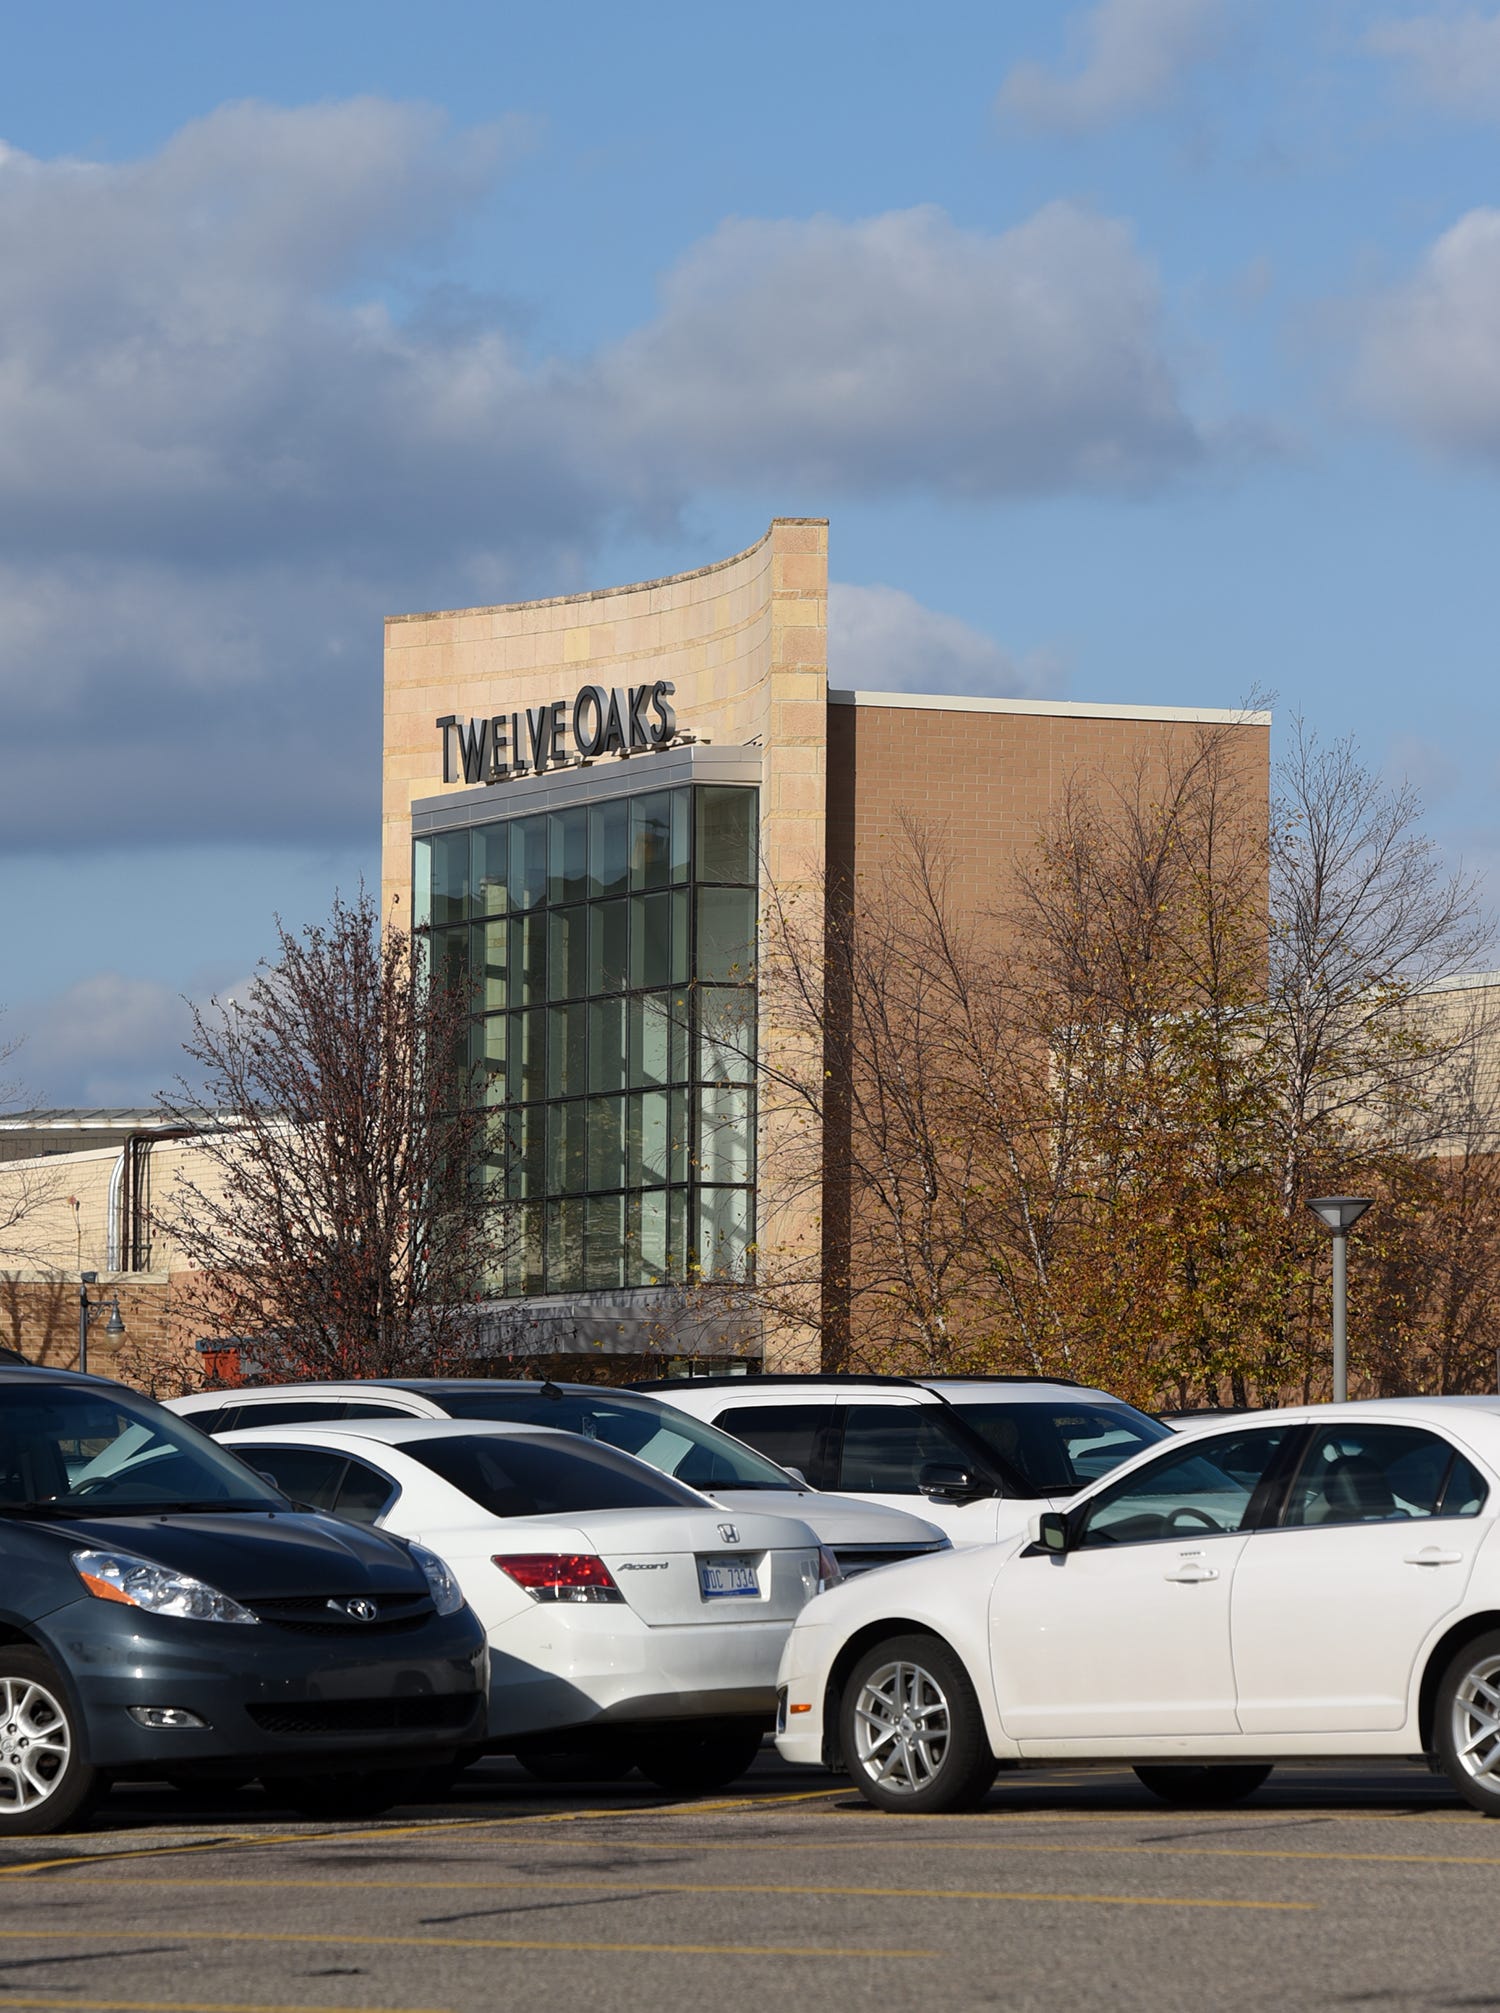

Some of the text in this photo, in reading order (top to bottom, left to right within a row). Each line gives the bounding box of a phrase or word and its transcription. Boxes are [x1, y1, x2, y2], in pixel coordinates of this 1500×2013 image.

[436, 680, 676, 784] TWELVE OAKS
[617, 1562, 669, 1572] Accord
[728, 1568, 755, 1588] 7334
